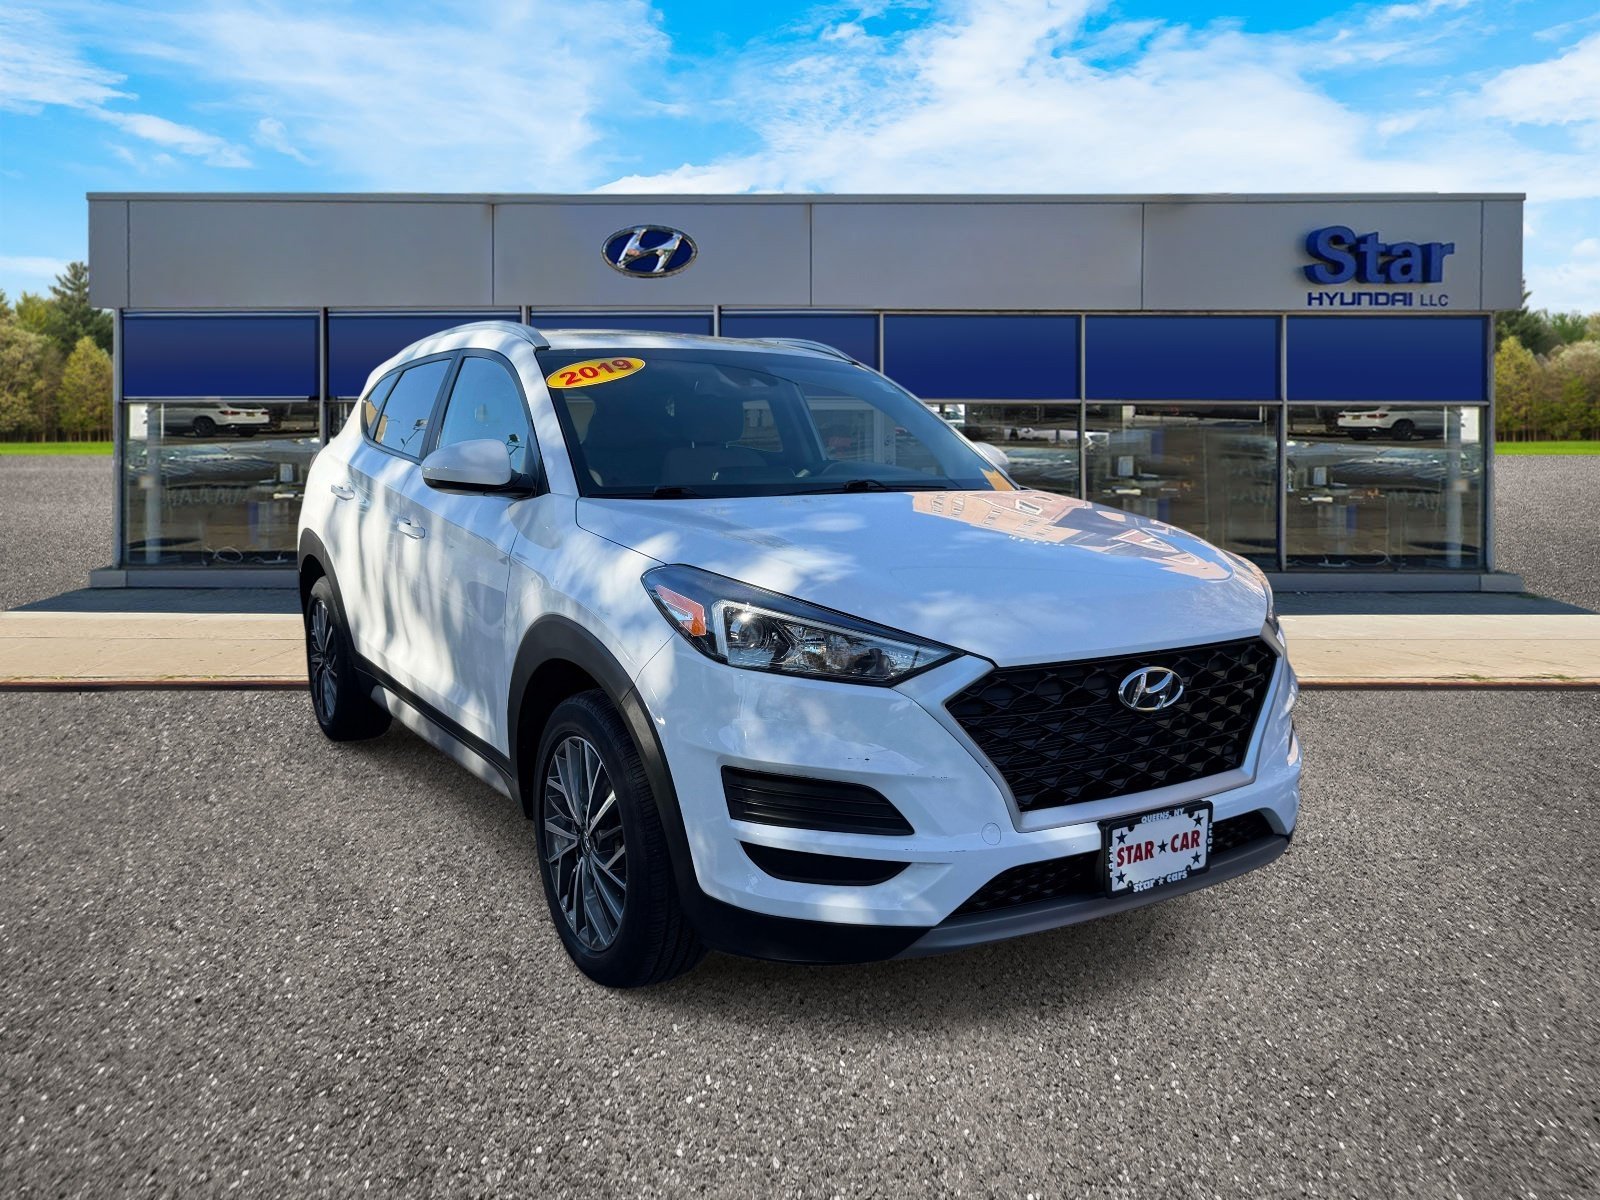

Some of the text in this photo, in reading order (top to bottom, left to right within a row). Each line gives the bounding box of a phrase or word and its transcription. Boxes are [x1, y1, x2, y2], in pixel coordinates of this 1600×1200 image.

[1303, 225, 1455, 284] Star
[1307, 292, 1449, 307] HYUNDAI LLC
[559, 359, 634, 386] 2019
[1173, 807, 1185, 817] NY
[1116, 829, 1201, 868] STAR CAR
[1133, 870, 1188, 893] star cars
